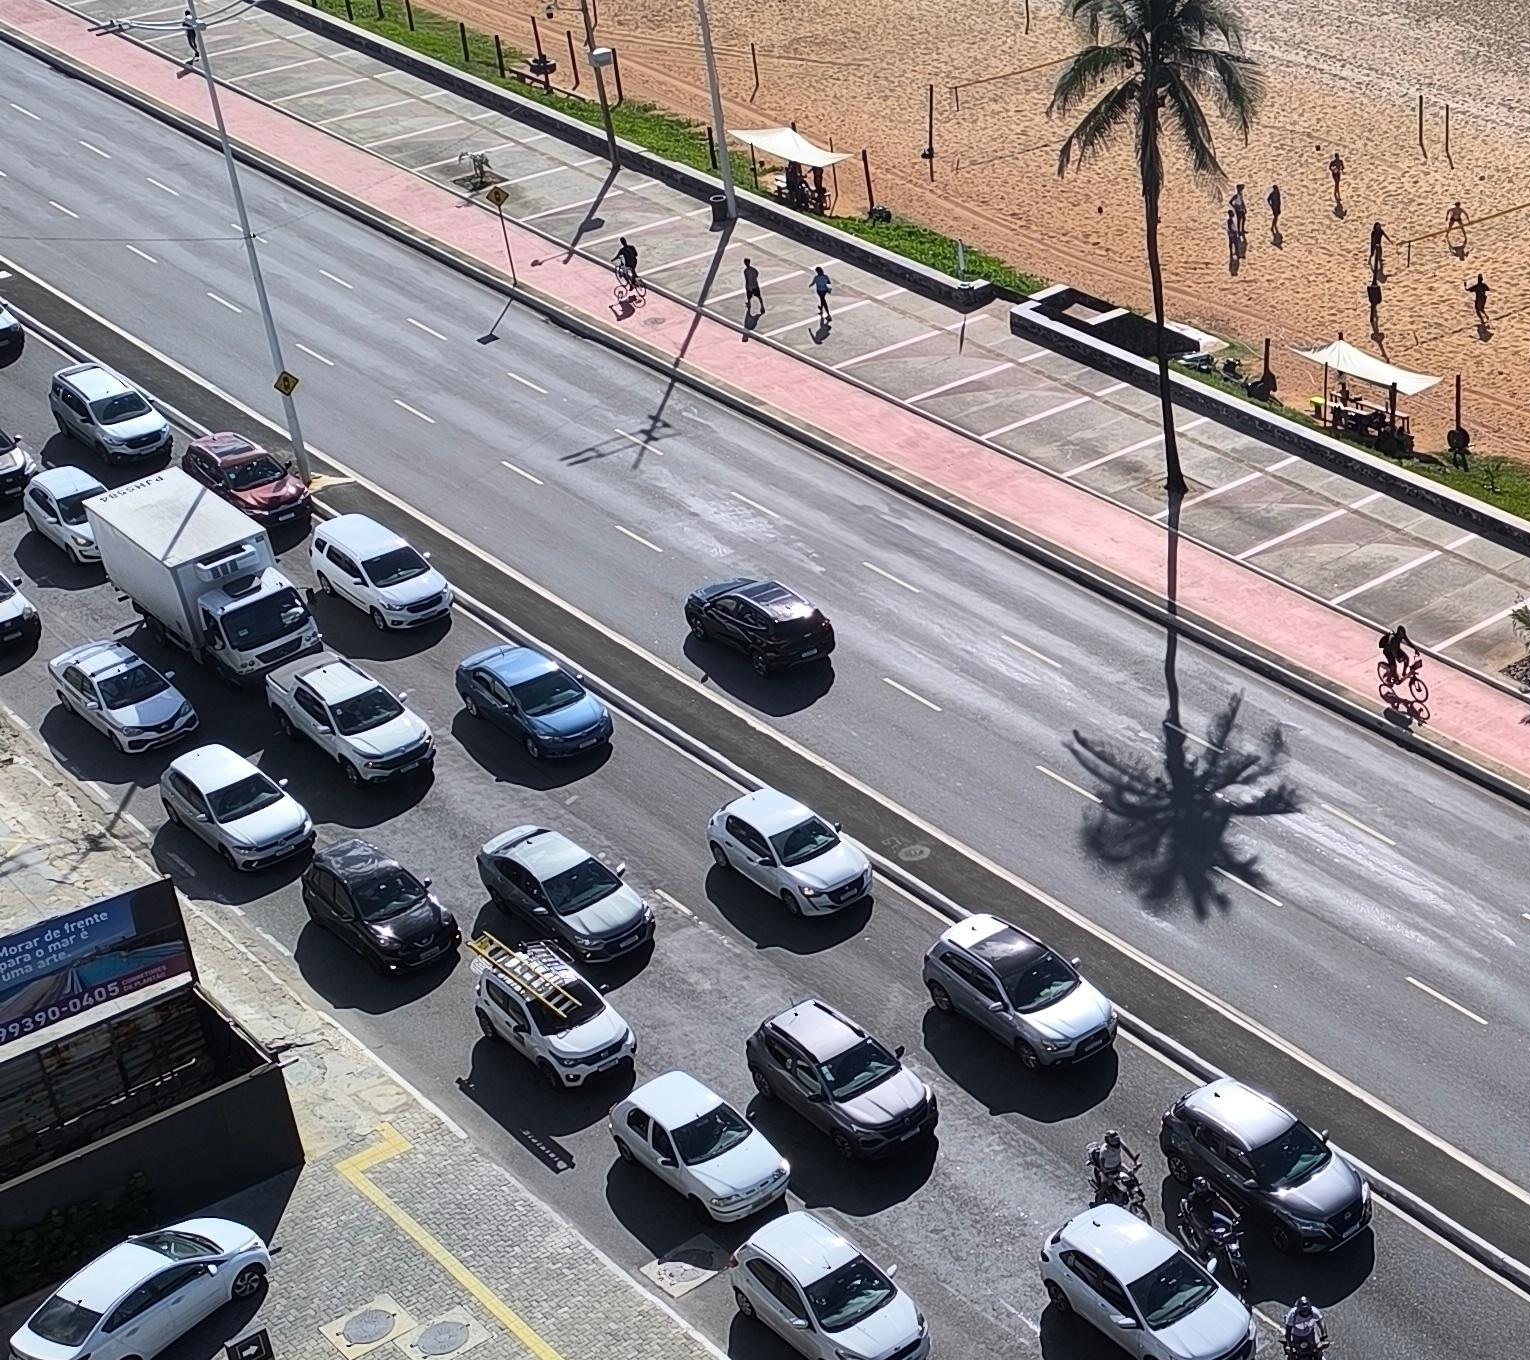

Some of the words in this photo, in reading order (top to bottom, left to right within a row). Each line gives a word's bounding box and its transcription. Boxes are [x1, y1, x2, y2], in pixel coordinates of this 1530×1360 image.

[0, 937, 40, 958] Morar
[44, 930, 61, 942] de
[64, 911, 109, 933] frente
[0, 951, 32, 973] para
[35, 948, 45, 958] o
[48, 934, 79, 952] mar
[80, 927, 89, 940] é
[1, 965, 33, 982] uma
[37, 949, 72, 969] arte.
